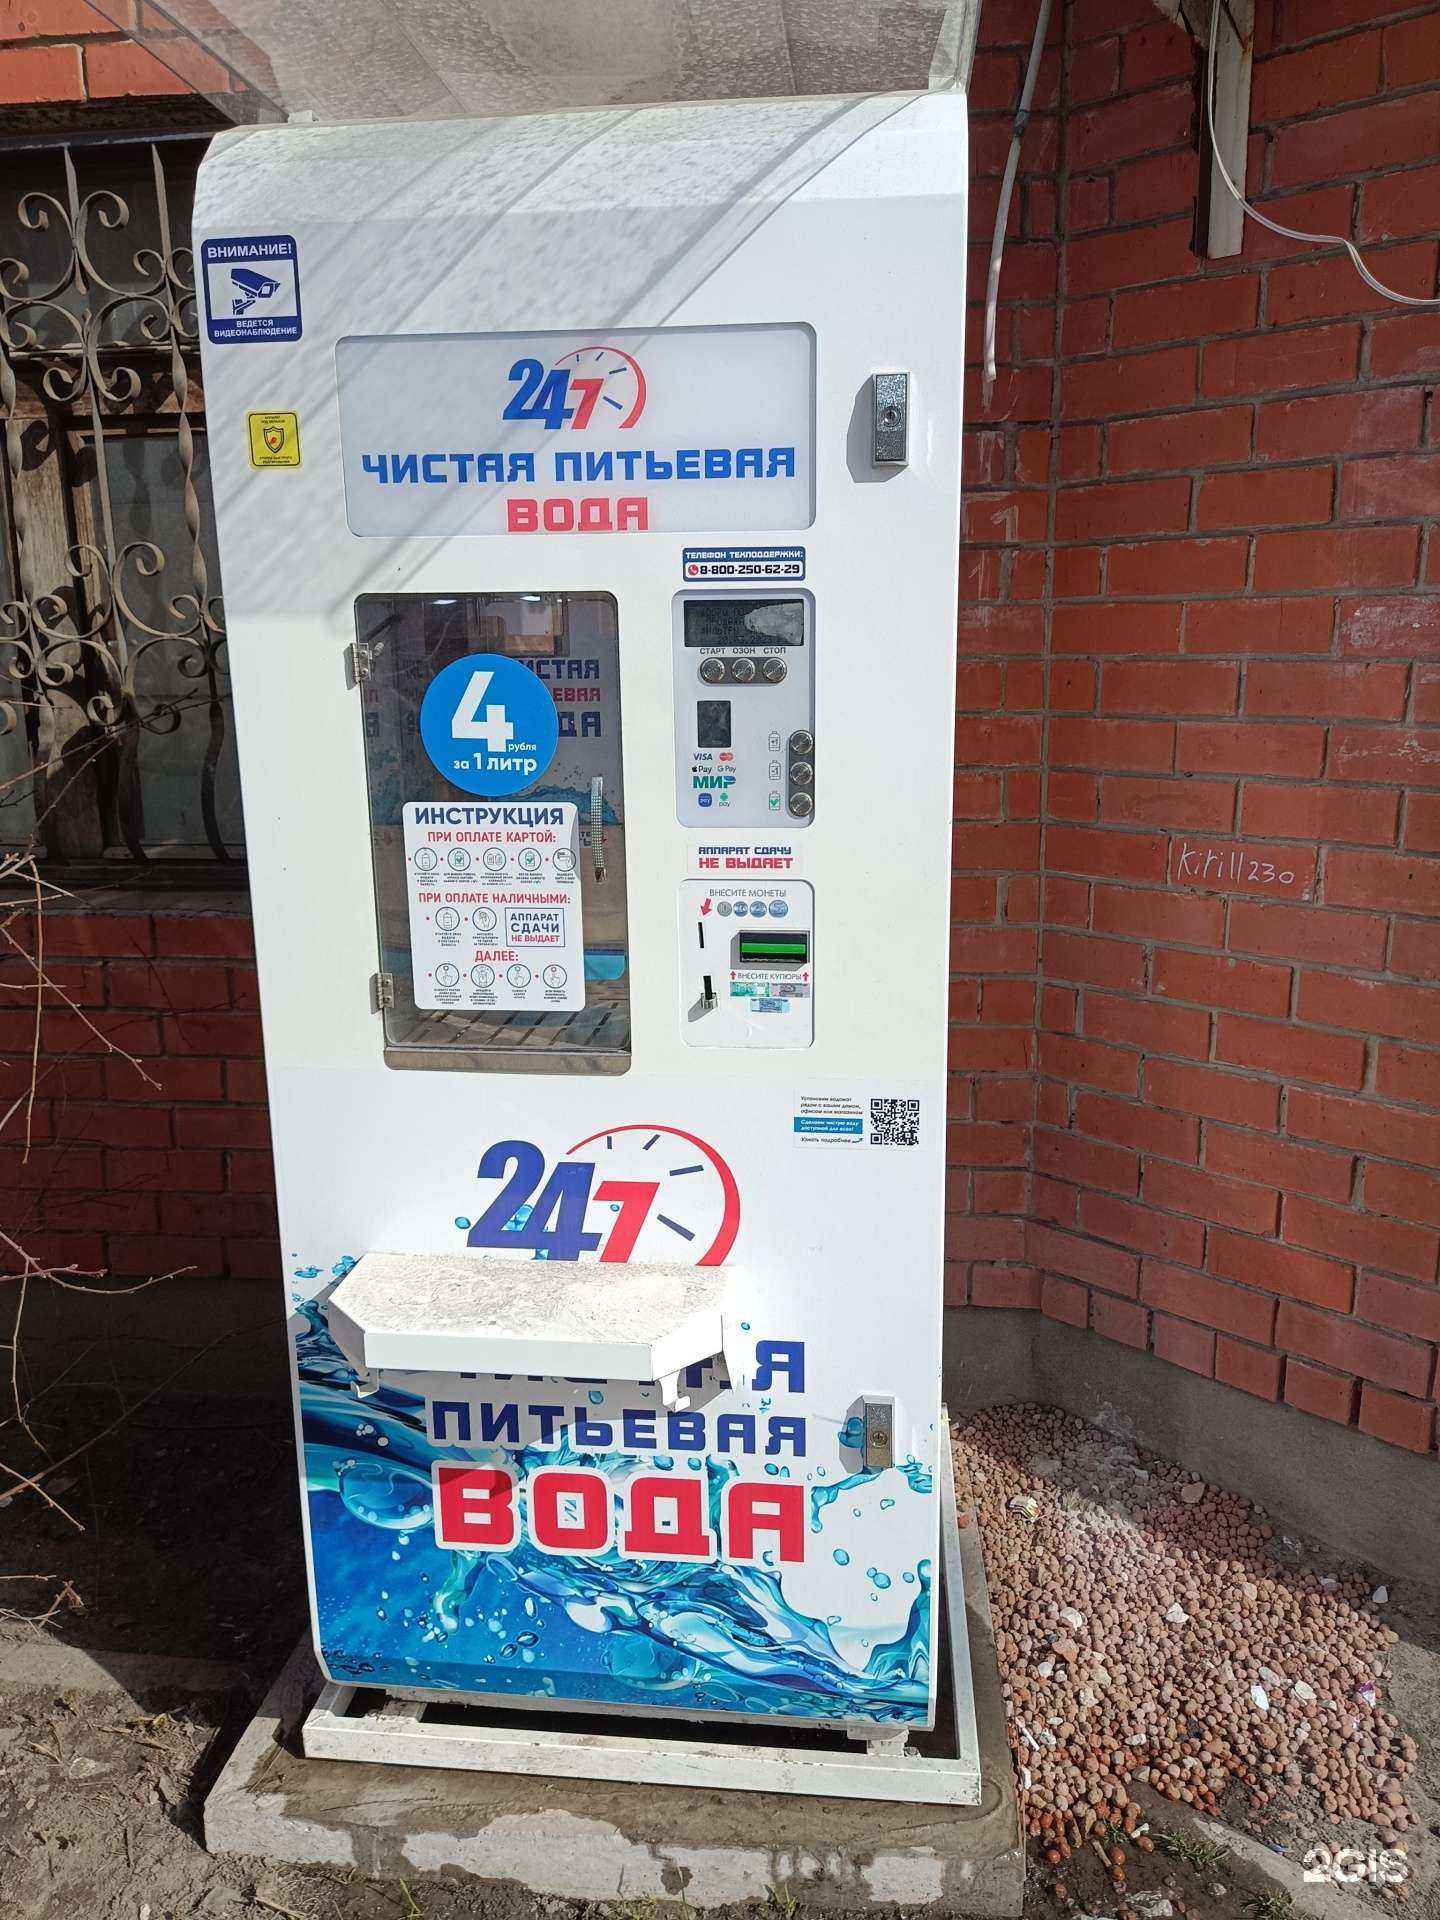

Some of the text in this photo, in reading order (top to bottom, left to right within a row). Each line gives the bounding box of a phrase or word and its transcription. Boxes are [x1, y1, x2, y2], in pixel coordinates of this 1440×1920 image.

[208, 243, 292, 259] ВНИМАНИЕ!
[236, 319, 274, 329] ВЕДЕТСЯ
[214, 326, 298, 338] ВИДЕОНАБЛЮДЕНИЕ
[362, 447, 795, 483] ЧИСТАЯ ПИТЬЕВАЯ
[508, 497, 649, 533] ВОДА
[686, 550, 804, 559] ТЕЛЕФОН ТЕХПОДДЕРЖКИ:
[700, 564, 800, 575] 8-800-250-62-29
[763, 646, 786, 654] СТОП
[518, 659, 600, 679] СТАЯ
[451, 670, 514, 752] 4
[508, 742, 537, 751] рубля
[693, 752, 713, 761] VISA
[453, 753, 538, 776] за 1 литр
[698, 765, 712, 774] Pay
[693, 775, 737, 789] МИР
[415, 807, 564, 828] ИНСТРУКЦИЯ
[427, 829, 557, 844] ПРИ ОПЛАТЕ КАРТОЙ:
[698, 846, 792, 855] АППАРАТ СДАЧУ
[699, 857, 794, 869] НЕ ВЫДАЕТ
[418, 892, 571, 904] ПРИ ОПЛАТЕ НАЛИЧНЫМИ:
[709, 888, 787, 898] ВНЕСИТЕ МОНЕТЫ
[510, 912, 560, 923] АППАРАТ
[510, 922, 560, 935] СДАЧИ
[511, 934, 561, 944] НЕ ВЫДАЕТ
[474, 950, 519, 962] ДАЛЕЕ:
[737, 972, 802, 981] ВНЕСИТЕ КУПЮРЫ
[432, 1401, 806, 1457] ПИТЬЕВАЯ
[438, 1467, 804, 1563] ВОДА
